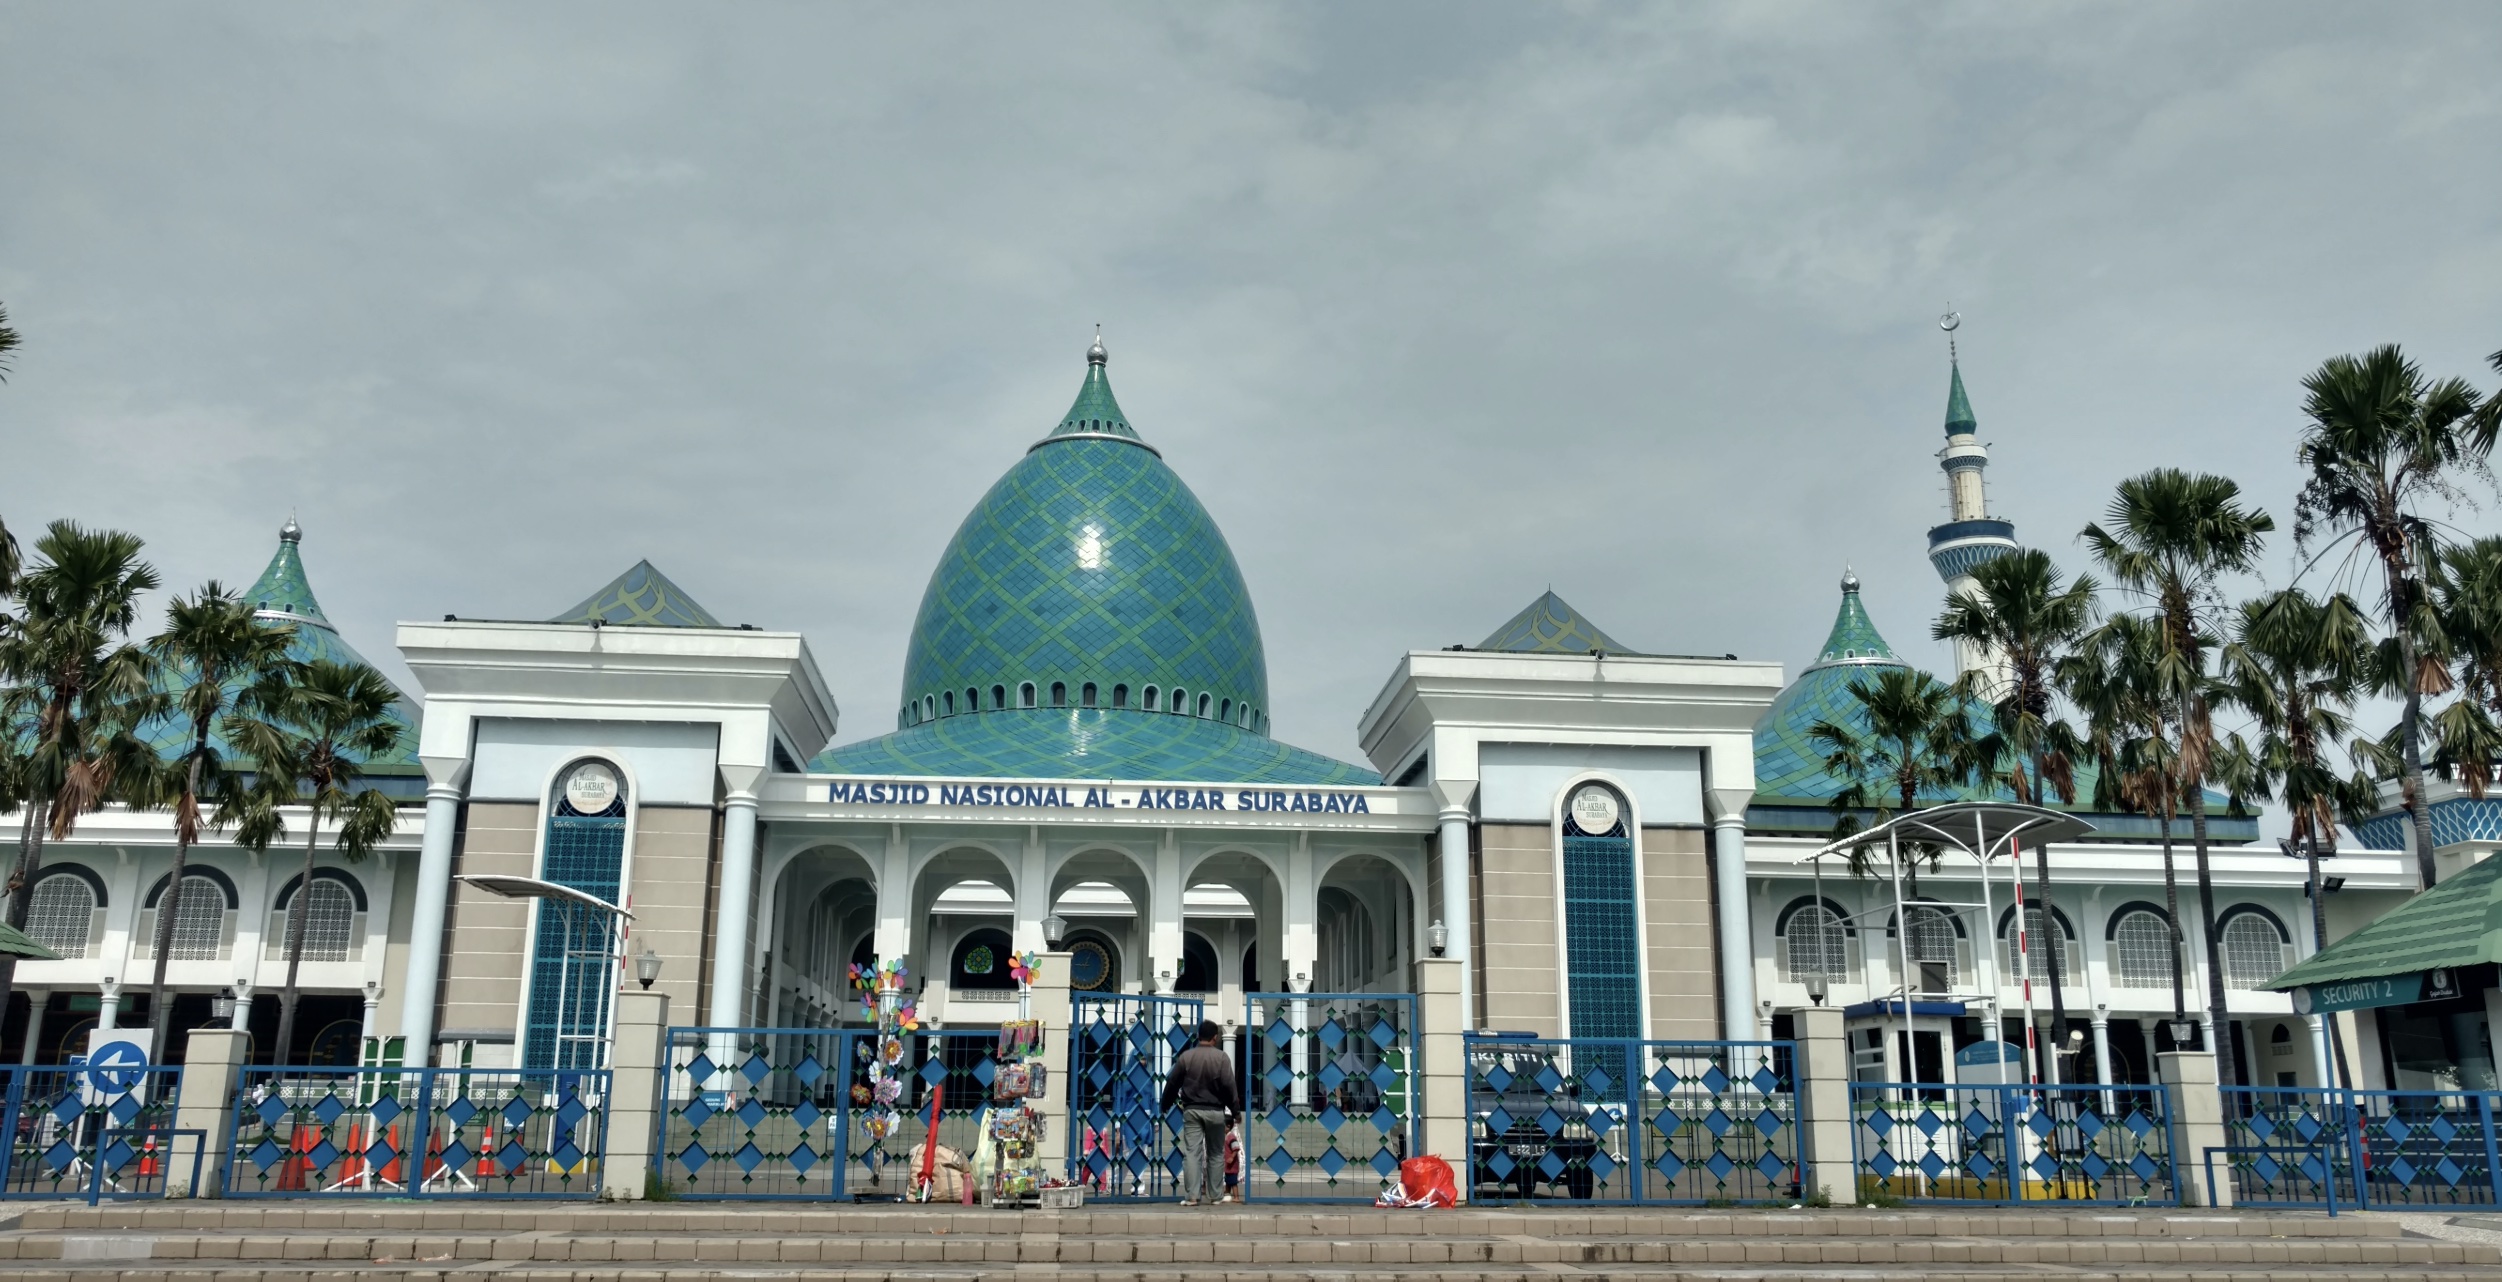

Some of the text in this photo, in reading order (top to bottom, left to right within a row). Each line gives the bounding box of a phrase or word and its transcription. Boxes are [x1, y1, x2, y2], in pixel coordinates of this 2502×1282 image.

[829, 783, 929, 805] MASJID
[941, 785, 1074, 807] NASIONAL
[1084, 788, 1115, 808] AL
[1137, 789, 1226, 811] AKBAR
[1237, 791, 1369, 814] SURABAYA
[2322, 980, 2393, 1005] SECURITY 2
